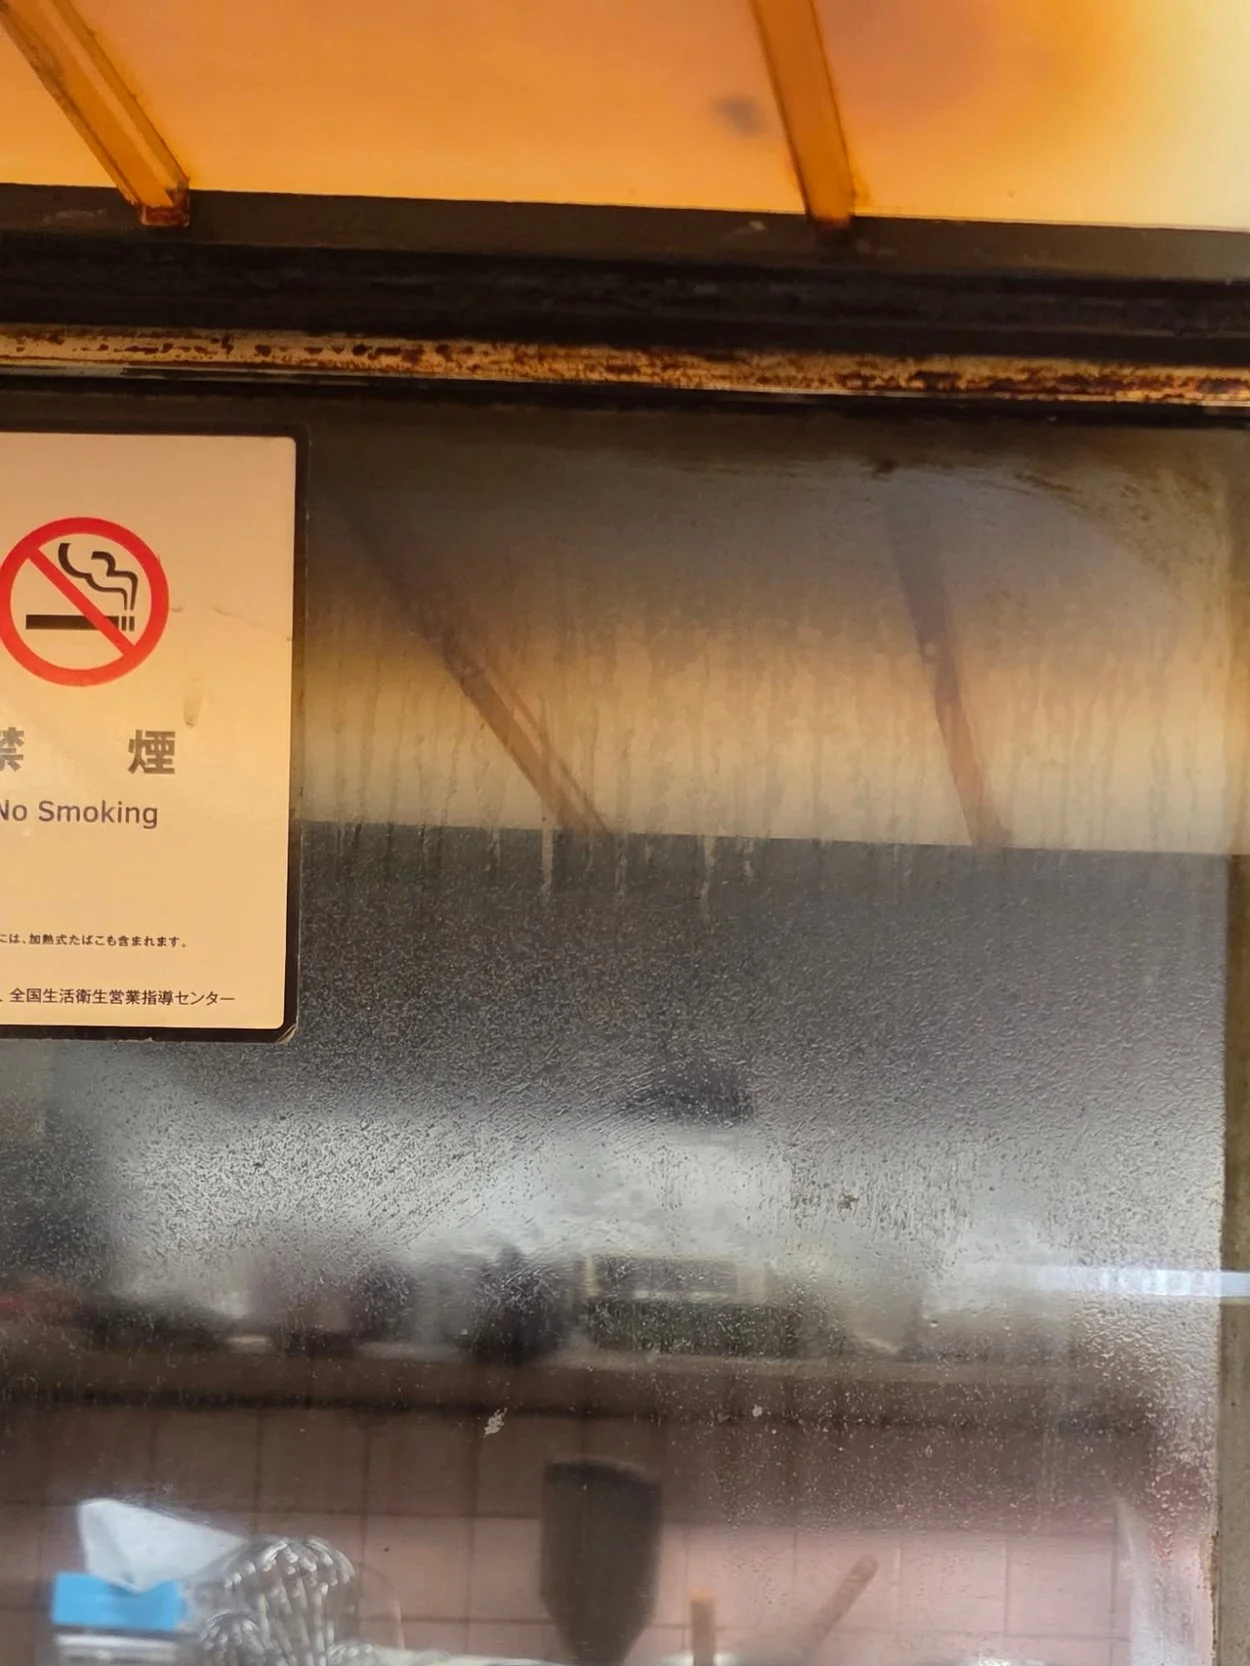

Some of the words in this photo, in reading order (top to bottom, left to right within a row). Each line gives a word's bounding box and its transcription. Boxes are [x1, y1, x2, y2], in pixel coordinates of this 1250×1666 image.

[128, 729, 176, 775] 煙
[38, 799, 158, 830] Smoking
[9, 986, 236, 1006] 全国生活衛生営業指導センター
